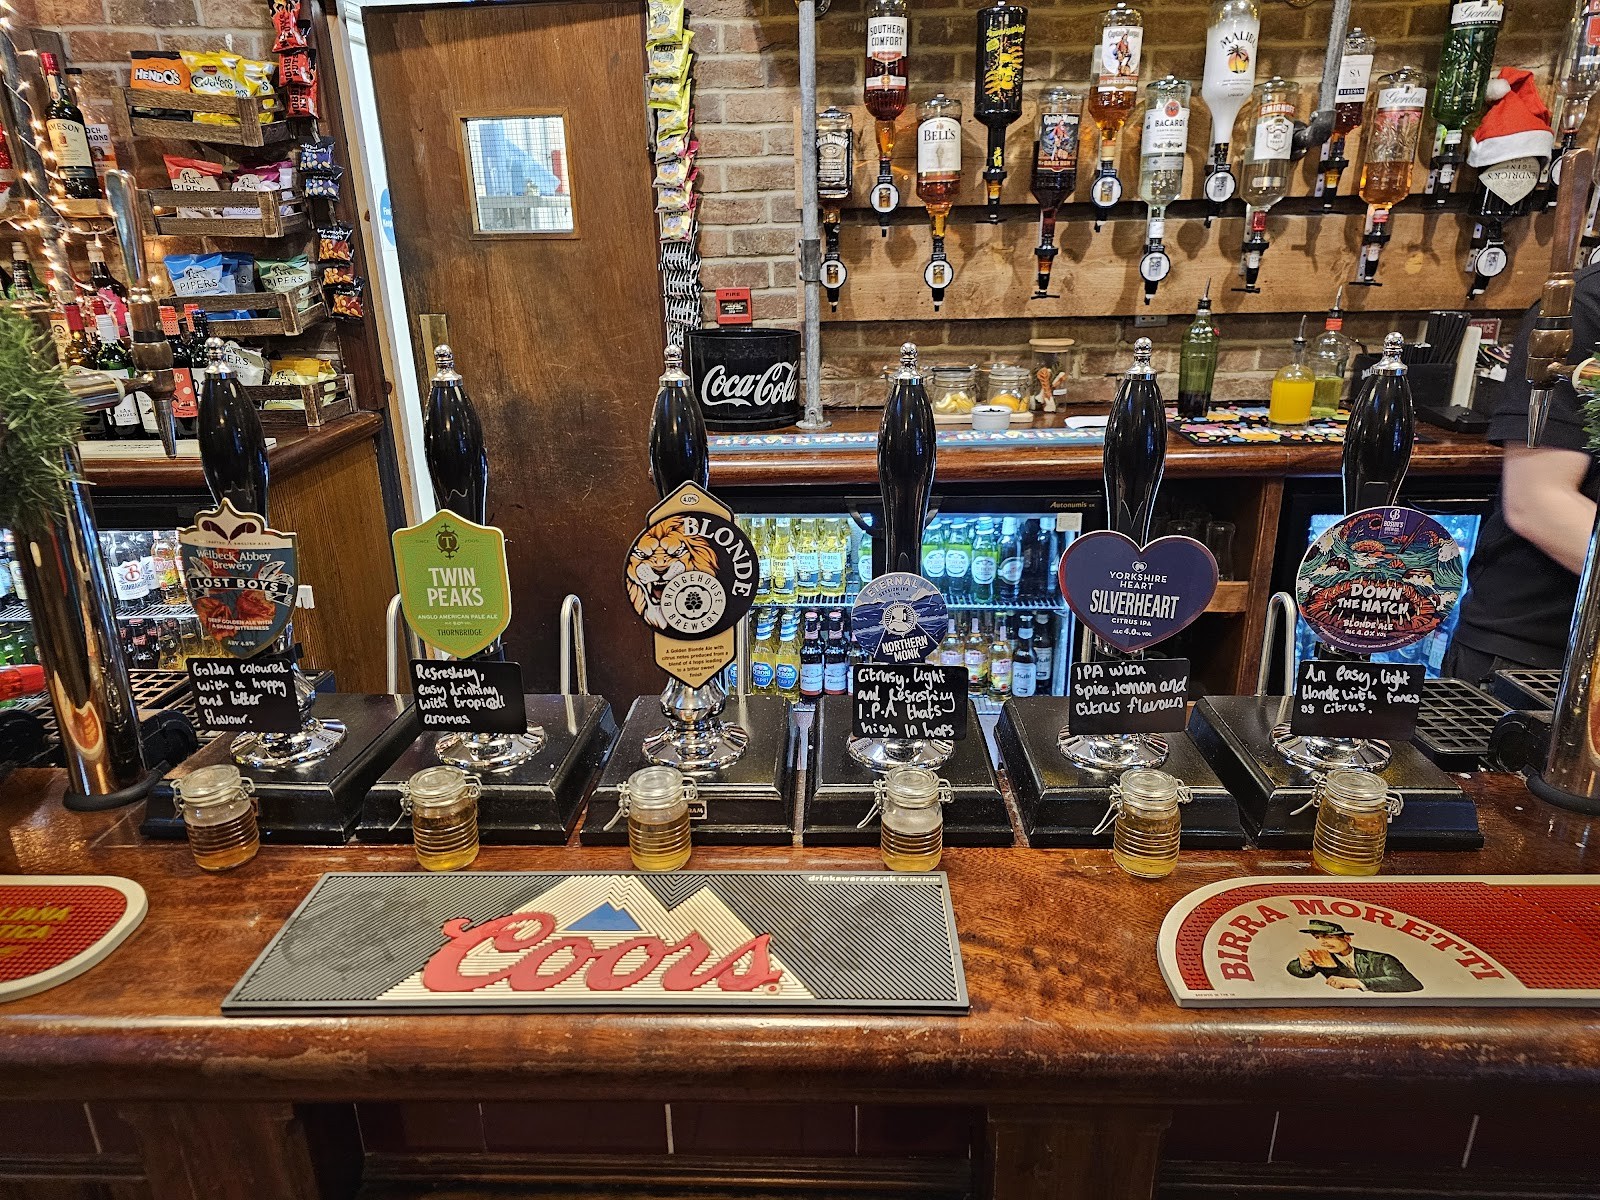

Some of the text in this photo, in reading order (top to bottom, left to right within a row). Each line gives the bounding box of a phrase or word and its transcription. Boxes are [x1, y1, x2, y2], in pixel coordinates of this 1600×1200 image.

[870, 24, 904, 36] SOUTHERN
[872, 36, 902, 46] COMFORT
[1220, 31, 1256, 49] MALIBU
[134, 68, 181, 86] HENDO'S
[48, 122, 80, 133] AMESON
[924, 128, 956, 141] BELL'S
[180, 279, 219, 291] PIPERS
[267, 276, 304, 287] PIPERS
[701, 361, 798, 406] Coca-Cola
[442, 536, 453, 549] T
[196, 549, 271, 563] Welbeck Abbey
[682, 516, 753, 598] BLONDE
[212, 561, 252, 571] Brewery
[196, 578, 279, 592] LOST BOYS
[428, 568, 476, 587] TWIN
[1110, 571, 1168, 583] YORKSHIRE
[1120, 580, 1154, 590] HEART
[664, 574, 723, 607] BRIDGEHOUSE
[866, 576, 918, 597] ETERNAL
[1350, 584, 1403, 601] DOWN
[427, 588, 484, 607] PEAKS
[1090, 589, 1180, 620] SILVERHEART
[1337, 597, 1409, 615] THE HATCH
[668, 610, 720, 631] BREWERY
[1343, 620, 1377, 629] BLONDE
[882, 635, 928, 654] NORTHERN
[894, 648, 920, 662] MONK
[192, 662, 289, 677] Golden coloured
[1076, 662, 1146, 680] IPA with
[1305, 663, 1326, 683] An
[1380, 669, 1411, 692] light
[196, 678, 286, 698] with a hoppy
[418, 682, 499, 700] easy drinking
[1160, 676, 1188, 693] and
[199, 692, 263, 707] and bitter
[858, 685, 880, 702] and
[1302, 685, 1420, 705] blonde with tones
[419, 698, 448, 710] with
[906, 703, 943, 721] thats
[1126, 697, 1184, 714] flavours
[424, 713, 471, 725] aromas
[861, 722, 898, 737] high
[923, 722, 955, 738] hops
[1216, 899, 1506, 982] BIRRA MORETTI
[422, 916, 782, 992] Coors
